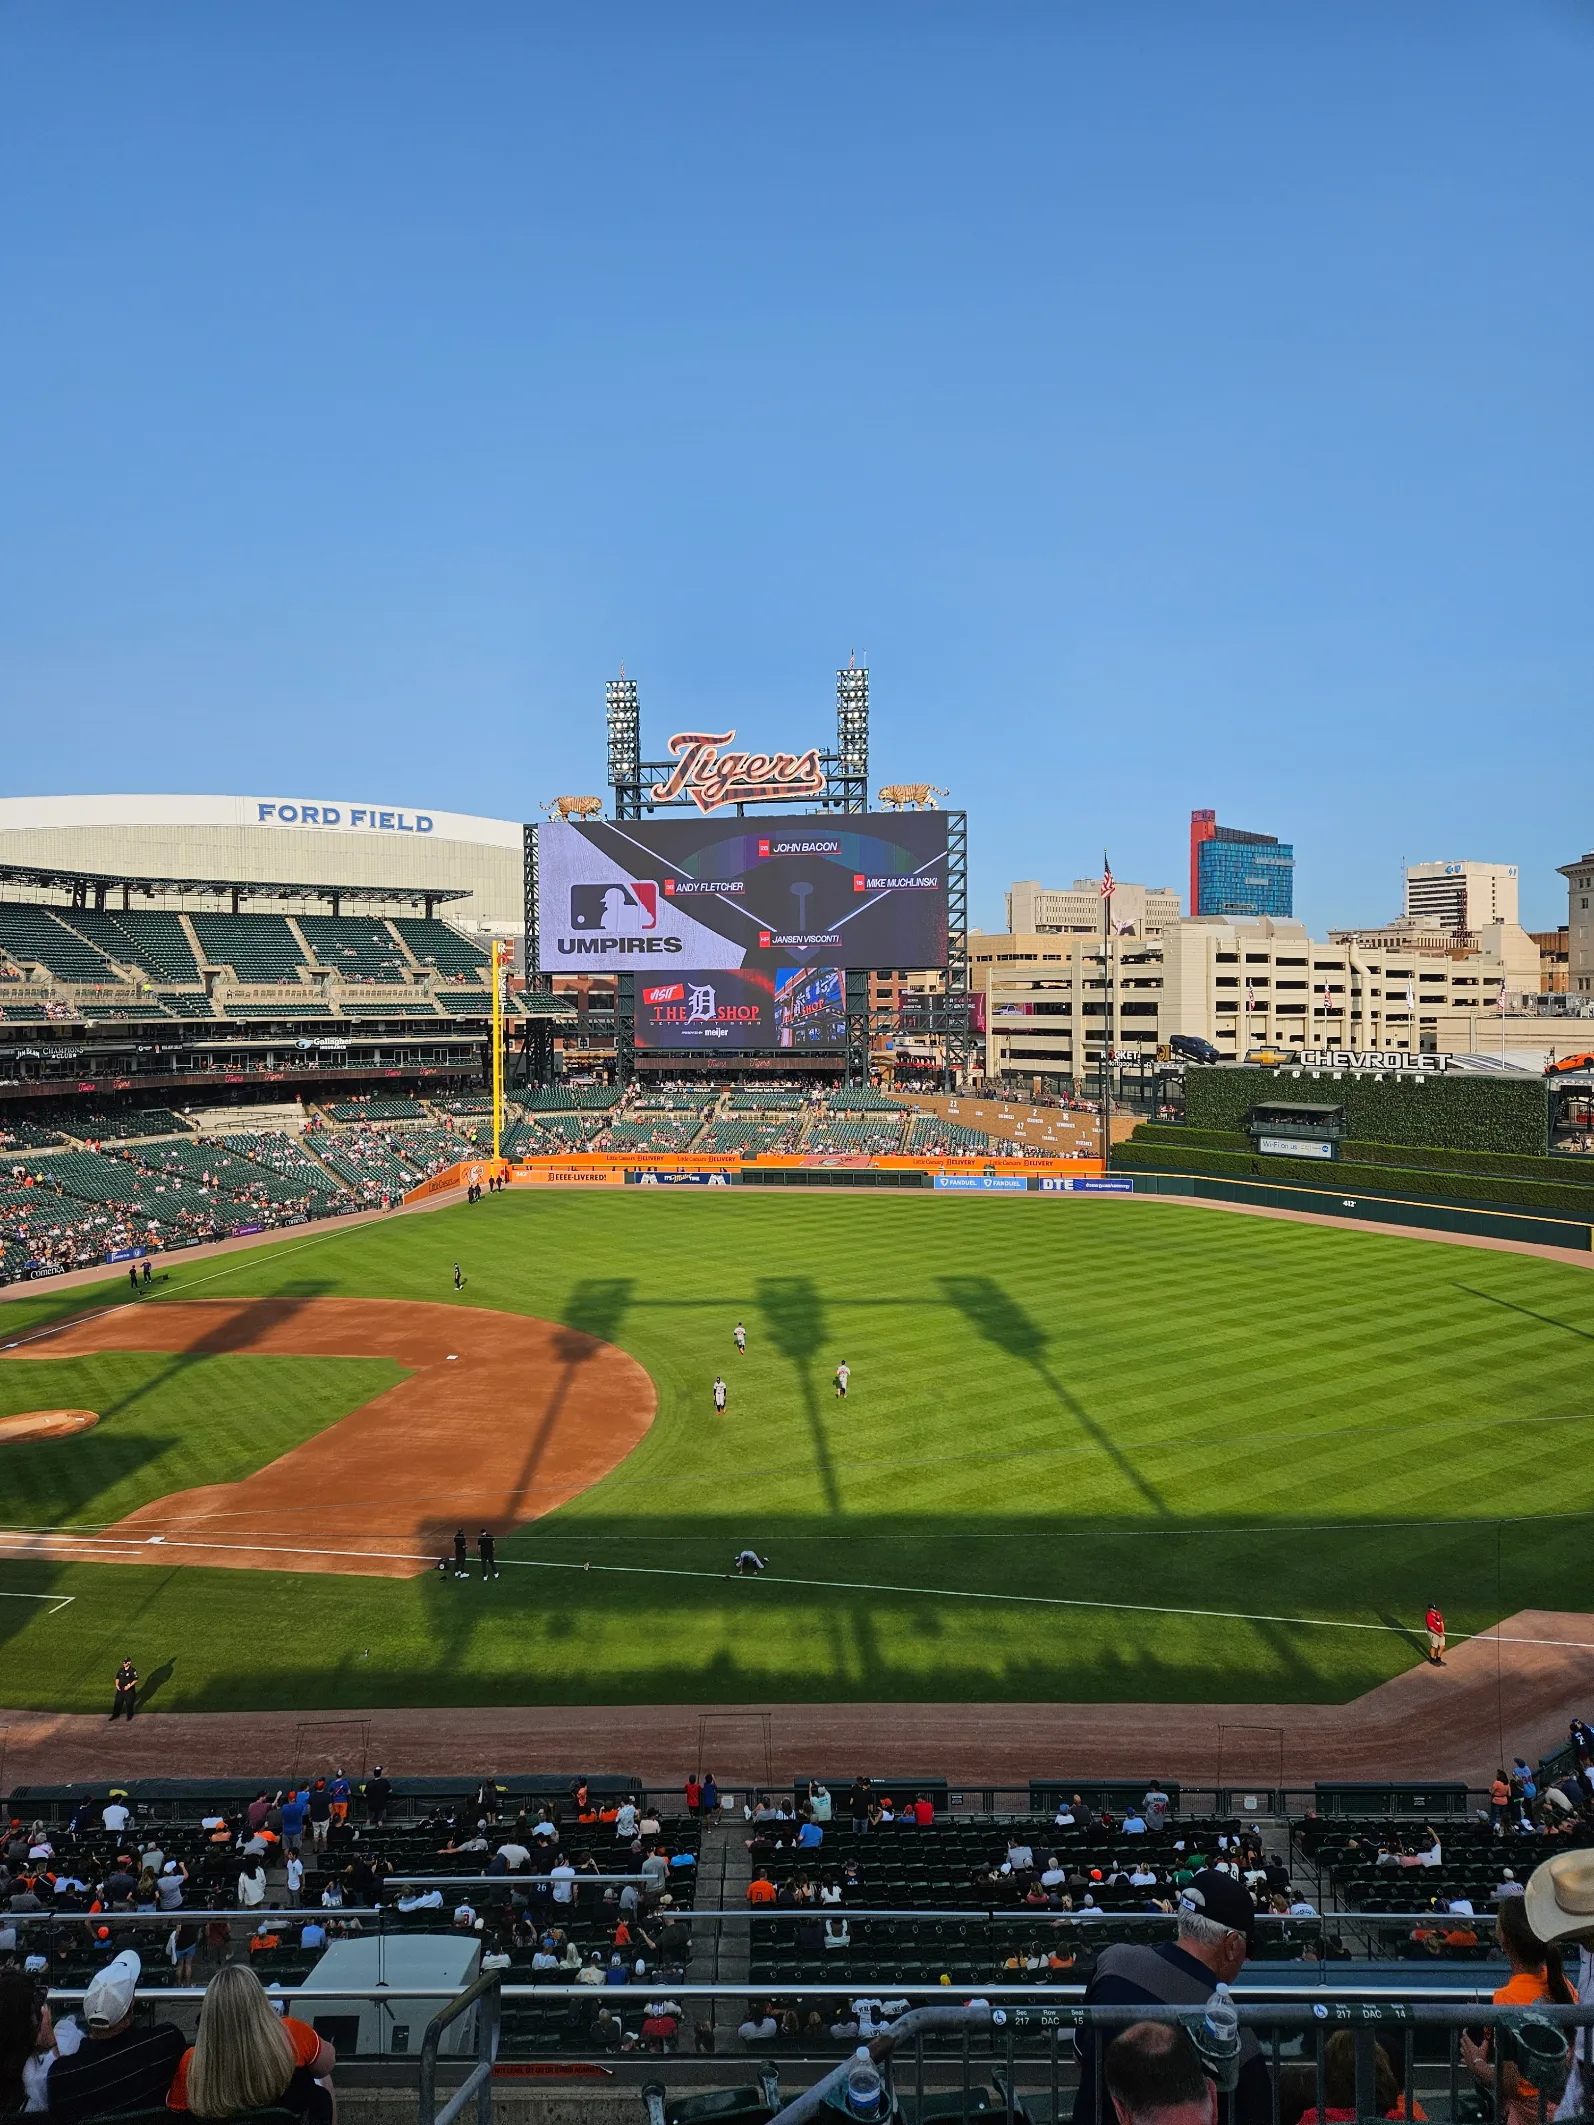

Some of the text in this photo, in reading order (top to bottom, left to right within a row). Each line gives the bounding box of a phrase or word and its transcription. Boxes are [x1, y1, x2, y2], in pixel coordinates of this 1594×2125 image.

[651, 730, 826, 814] Tigers
[257, 803, 434, 833] FORD FIELD
[773, 843, 801, 853] JOHN
[802, 842, 838, 852] BACON
[676, 883, 700, 892] ANDY
[700, 882, 744, 892] FLETCHER
[866, 879, 886, 888] MIKE
[887, 878, 938, 887] MUCHLINSKI
[772, 935, 803, 944] JANSEN
[803, 934, 840, 943] VISCONTI
[557, 936, 683, 955] UMPIRES
[650, 986, 678, 1001] VISIT
[801, 999, 826, 1016] SHOP
[654, 1006, 687, 1020] THE
[717, 1006, 760, 1020] SHOP
[704, 1027, 729, 1038] meijer
[313, 1037, 352, 1047] Gallagher
[15, 1047, 41, 1059] JIM BEAM
[43, 1046, 84, 1056] CHAMPIONS
[1100, 1050, 1140, 1061] ROCKET
[750, 1058, 771, 1068] Tigers
[1300, 1049, 1453, 1071] CHEVROLET
[1274, 1069, 1425, 1084] FOUNTAIN
[950, 1100, 957, 1108] 23
[1032, 1108, 1038, 1116] 2
[1062, 1112, 1069, 1121] 16
[1016, 1122, 1024, 1130] 47
[1095, 1117, 1100, 1126] 6
[1047, 1126, 1052, 1134] 3
[1263, 1140, 1280, 1149] Wi-Fi
[949, 1179, 977, 1187] FANDUEL
[993, 1179, 1021, 1187] FANDUEL
[1043, 1178, 1074, 1191] DTE
[1343, 1200, 1357, 1208] 412'
[537, 1883, 547, 1892] 26
[1336, 2010, 1406, 2019] 217 DAC 14
[1015, 2017, 1084, 2025] 217 DAC 15
